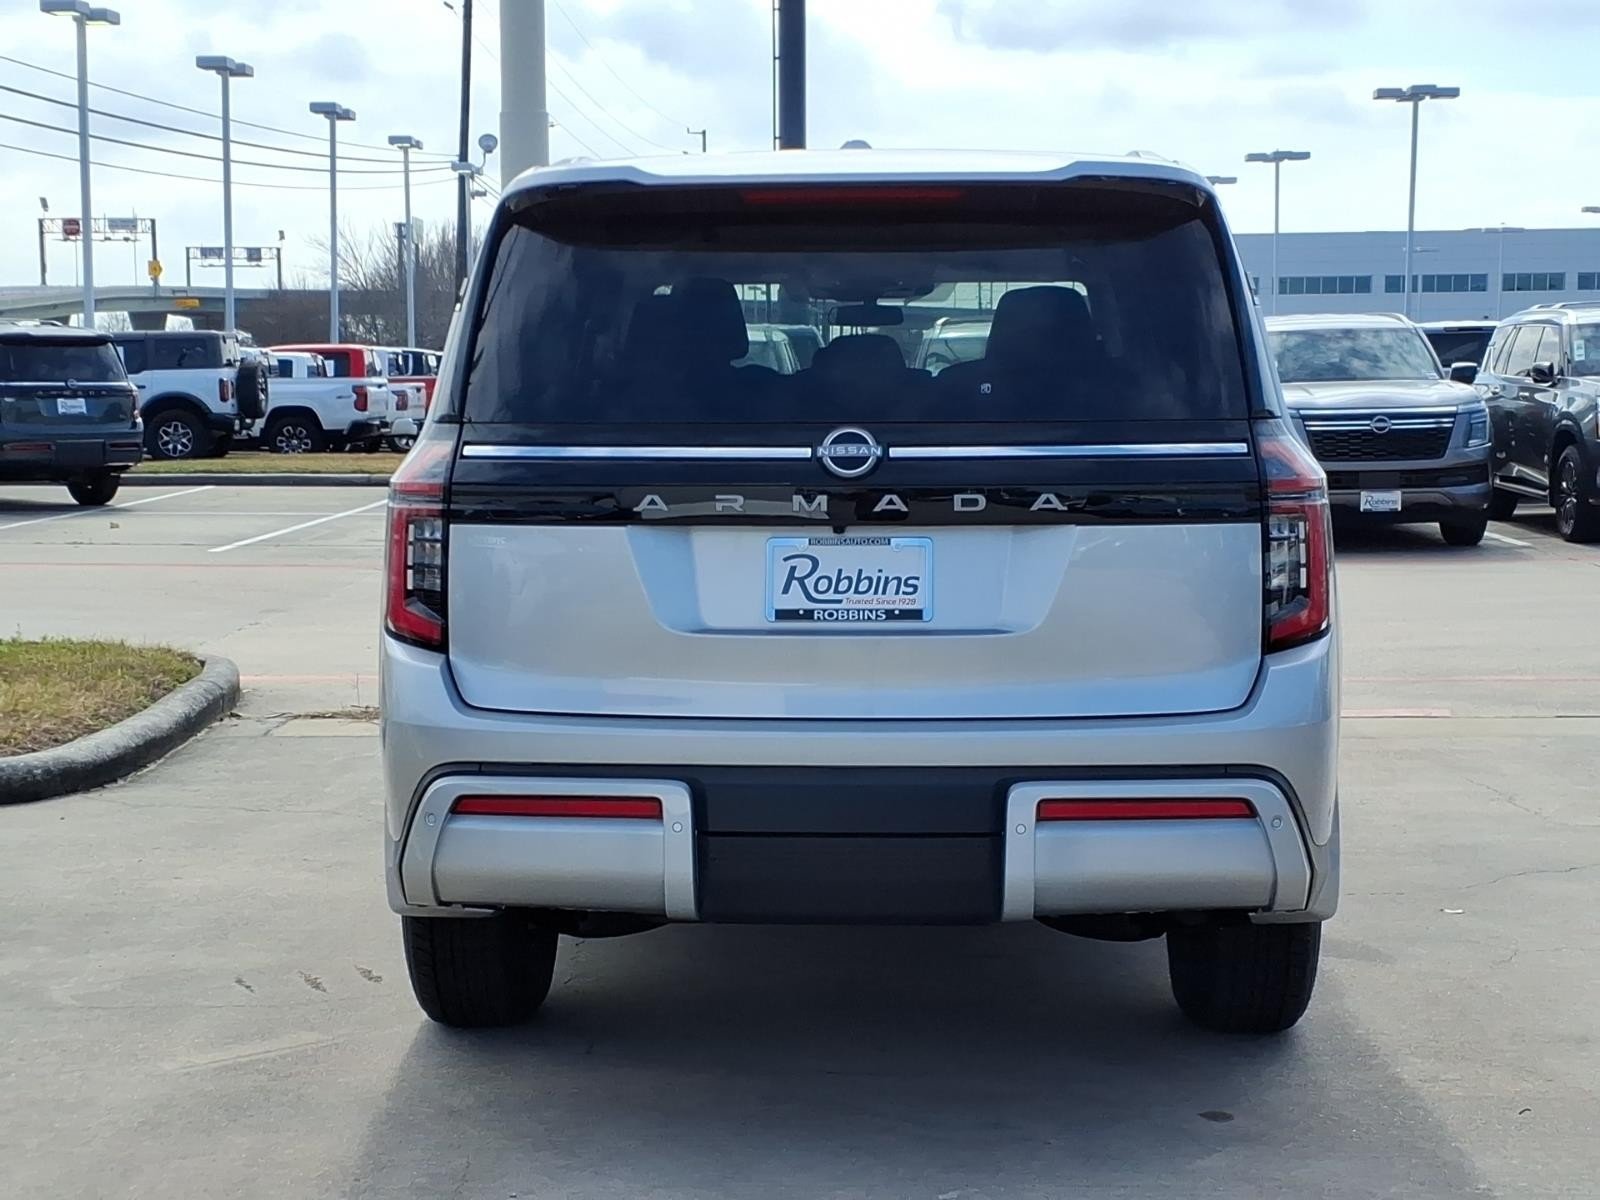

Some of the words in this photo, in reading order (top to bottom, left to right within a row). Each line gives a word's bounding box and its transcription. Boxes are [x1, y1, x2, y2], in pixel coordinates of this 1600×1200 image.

[818, 446, 881, 456] NISSAN
[633, 494, 1068, 512] ARMADA
[781, 553, 920, 604] Robbins
[845, 597, 874, 605] Trusted
[876, 597, 897, 605] Since
[898, 598, 917, 606] 1928
[813, 609, 887, 621] ROBBINS
